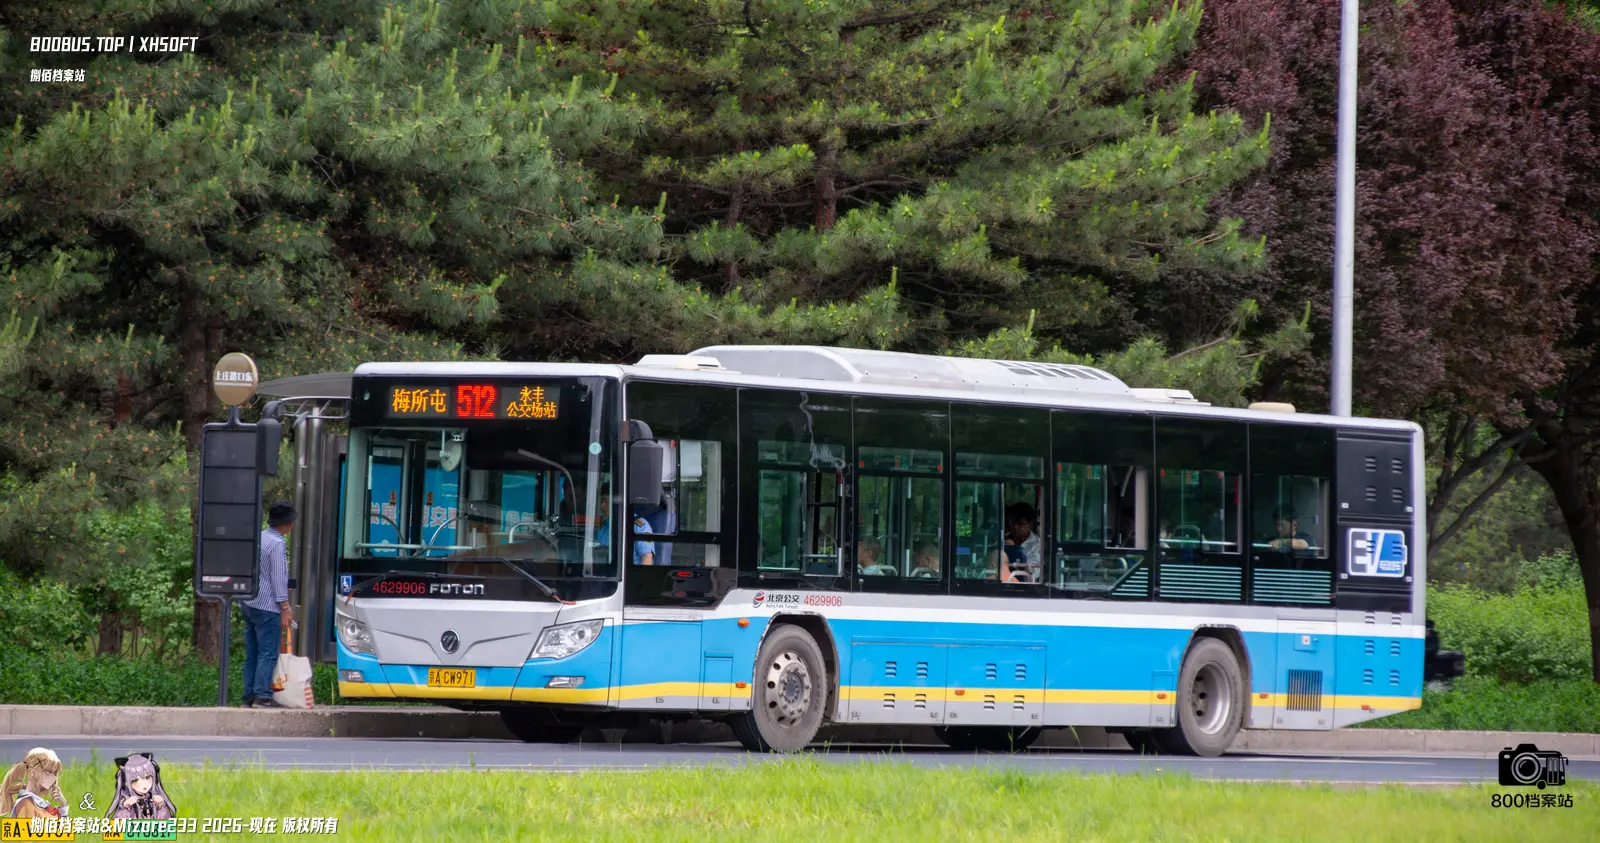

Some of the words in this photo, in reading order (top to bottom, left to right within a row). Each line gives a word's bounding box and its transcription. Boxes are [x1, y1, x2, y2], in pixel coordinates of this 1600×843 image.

[392, 388, 447, 413] 梅所屯
[456, 384, 497, 418] 512
[519, 386, 545, 403] 永丰
[506, 401, 557, 419] 公交场站
[373, 582, 426, 594] 4629906
[429, 583, 485, 595] FOTON
[767, 594, 800, 603] 北京公交
[804, 595, 842, 607] 4629906
